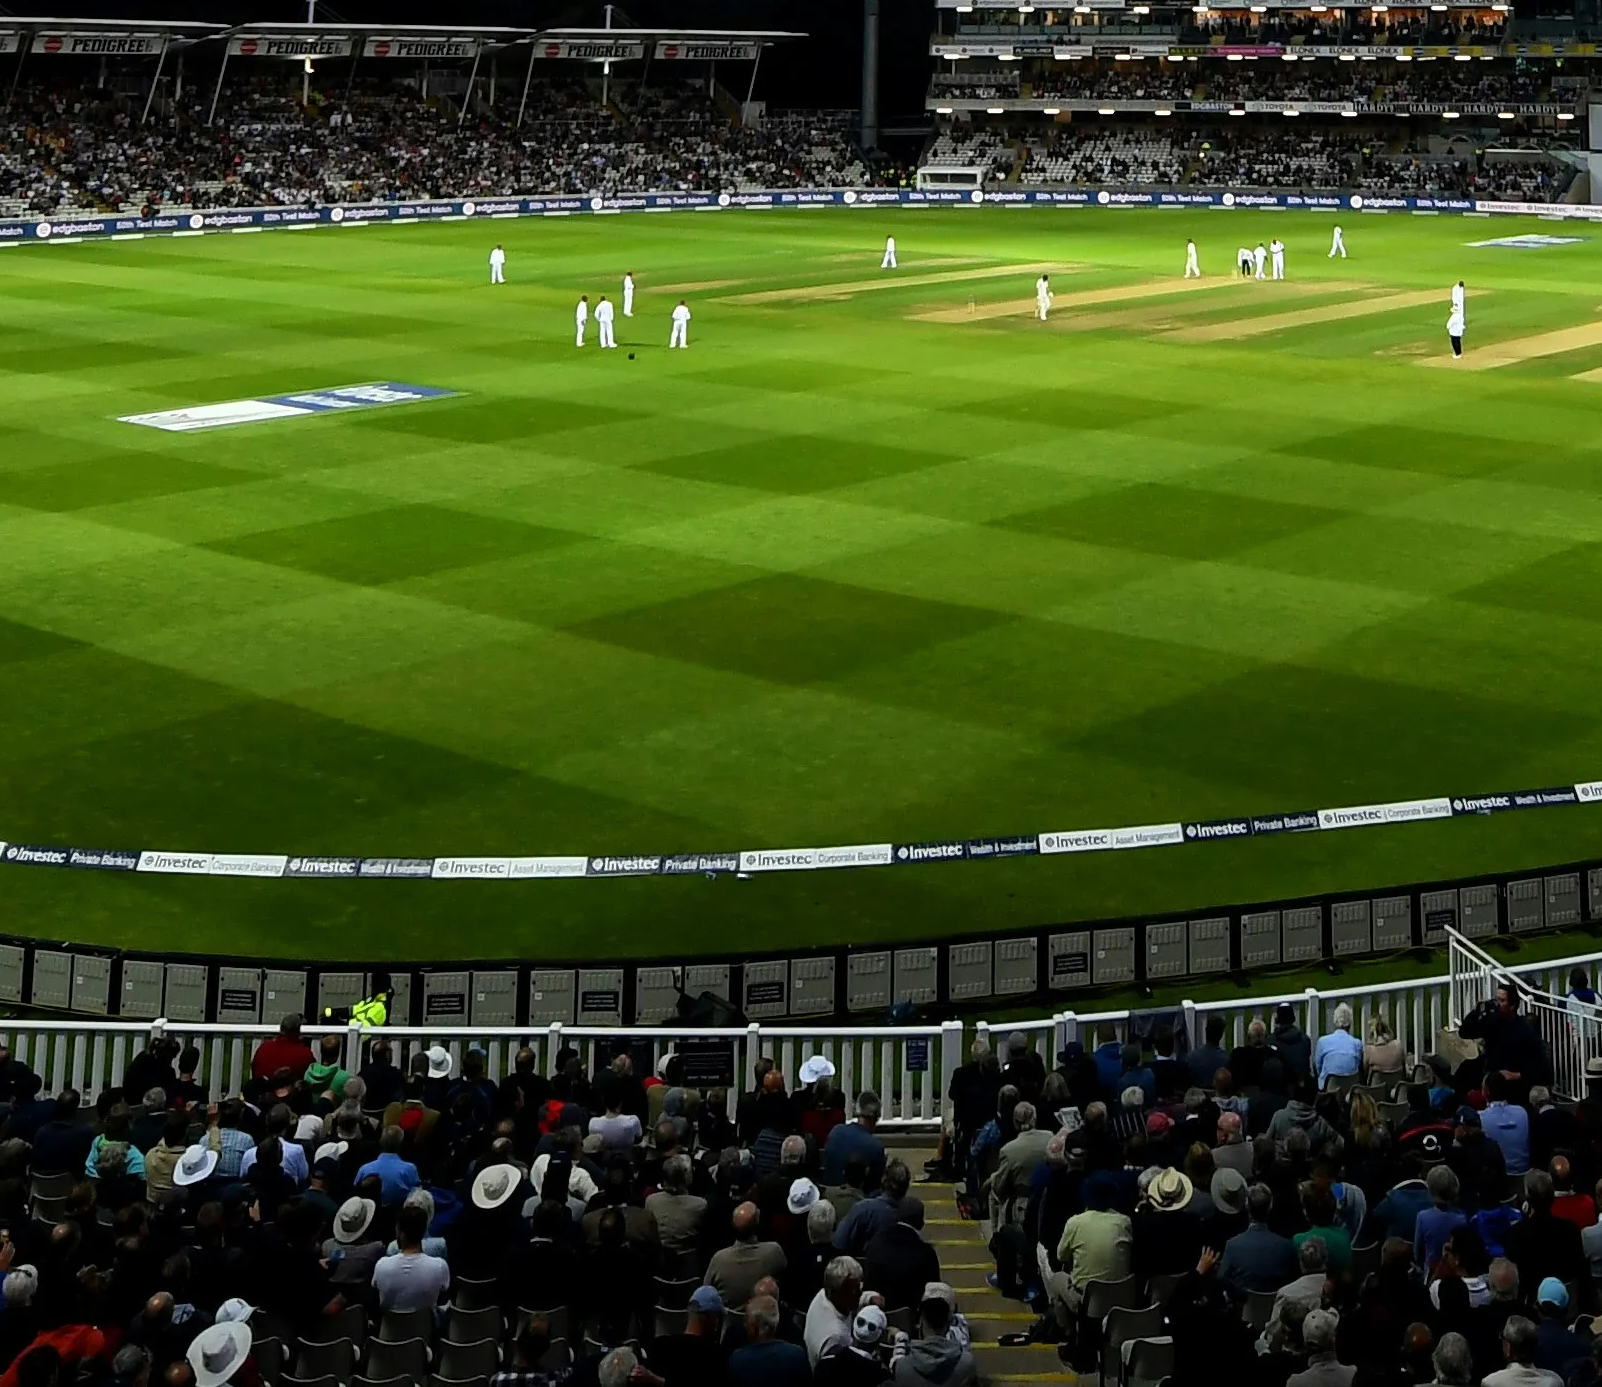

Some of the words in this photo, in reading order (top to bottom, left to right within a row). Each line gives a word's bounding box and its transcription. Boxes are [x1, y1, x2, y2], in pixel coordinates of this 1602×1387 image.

[70, 39, 146, 53] PEDIGREE
[266, 40, 335, 54] PEDIGREE
[397, 43, 463, 57] PEDIGREE
[567, 44, 629, 58] PEDIGREE
[685, 45, 745, 59] PEDIGREE
[1291, 47, 1320, 55] ELONEX
[1329, 47, 1359, 55] ELONEX
[1486, 203, 1520, 211] Investec
[1534, 205, 1568, 213] Investec
[53, 222, 104, 234] edgbaston
[1197, 822, 1247, 838] Investec
[1253, 819, 1282, 832] Private
[1284, 815, 1316, 828] Banking
[1055, 834, 1107, 848] Investec
[1115, 835, 1134, 845] Asset
[1136, 829, 1179, 843] Management
[17, 847, 66, 863] Investec
[70, 854, 100, 865] Private
[101, 854, 136, 868] Banking
[758, 854, 811, 866] Investec
[818, 852, 856, 864] Corporate
[858, 850, 888, 862] Banking
[909, 845, 963, 859] Investec
[155, 855, 206, 869] Investec
[212, 860, 249, 872] Corporate
[251, 862, 281, 874] Banking
[301, 859, 355, 873] Investec
[450, 861, 505, 874] Investec
[513, 863, 534, 874] Asset
[536, 862, 584, 875] Management
[604, 857, 659, 872] Investec
[665, 859, 697, 870] Private
[699, 858, 736, 871] Banking
